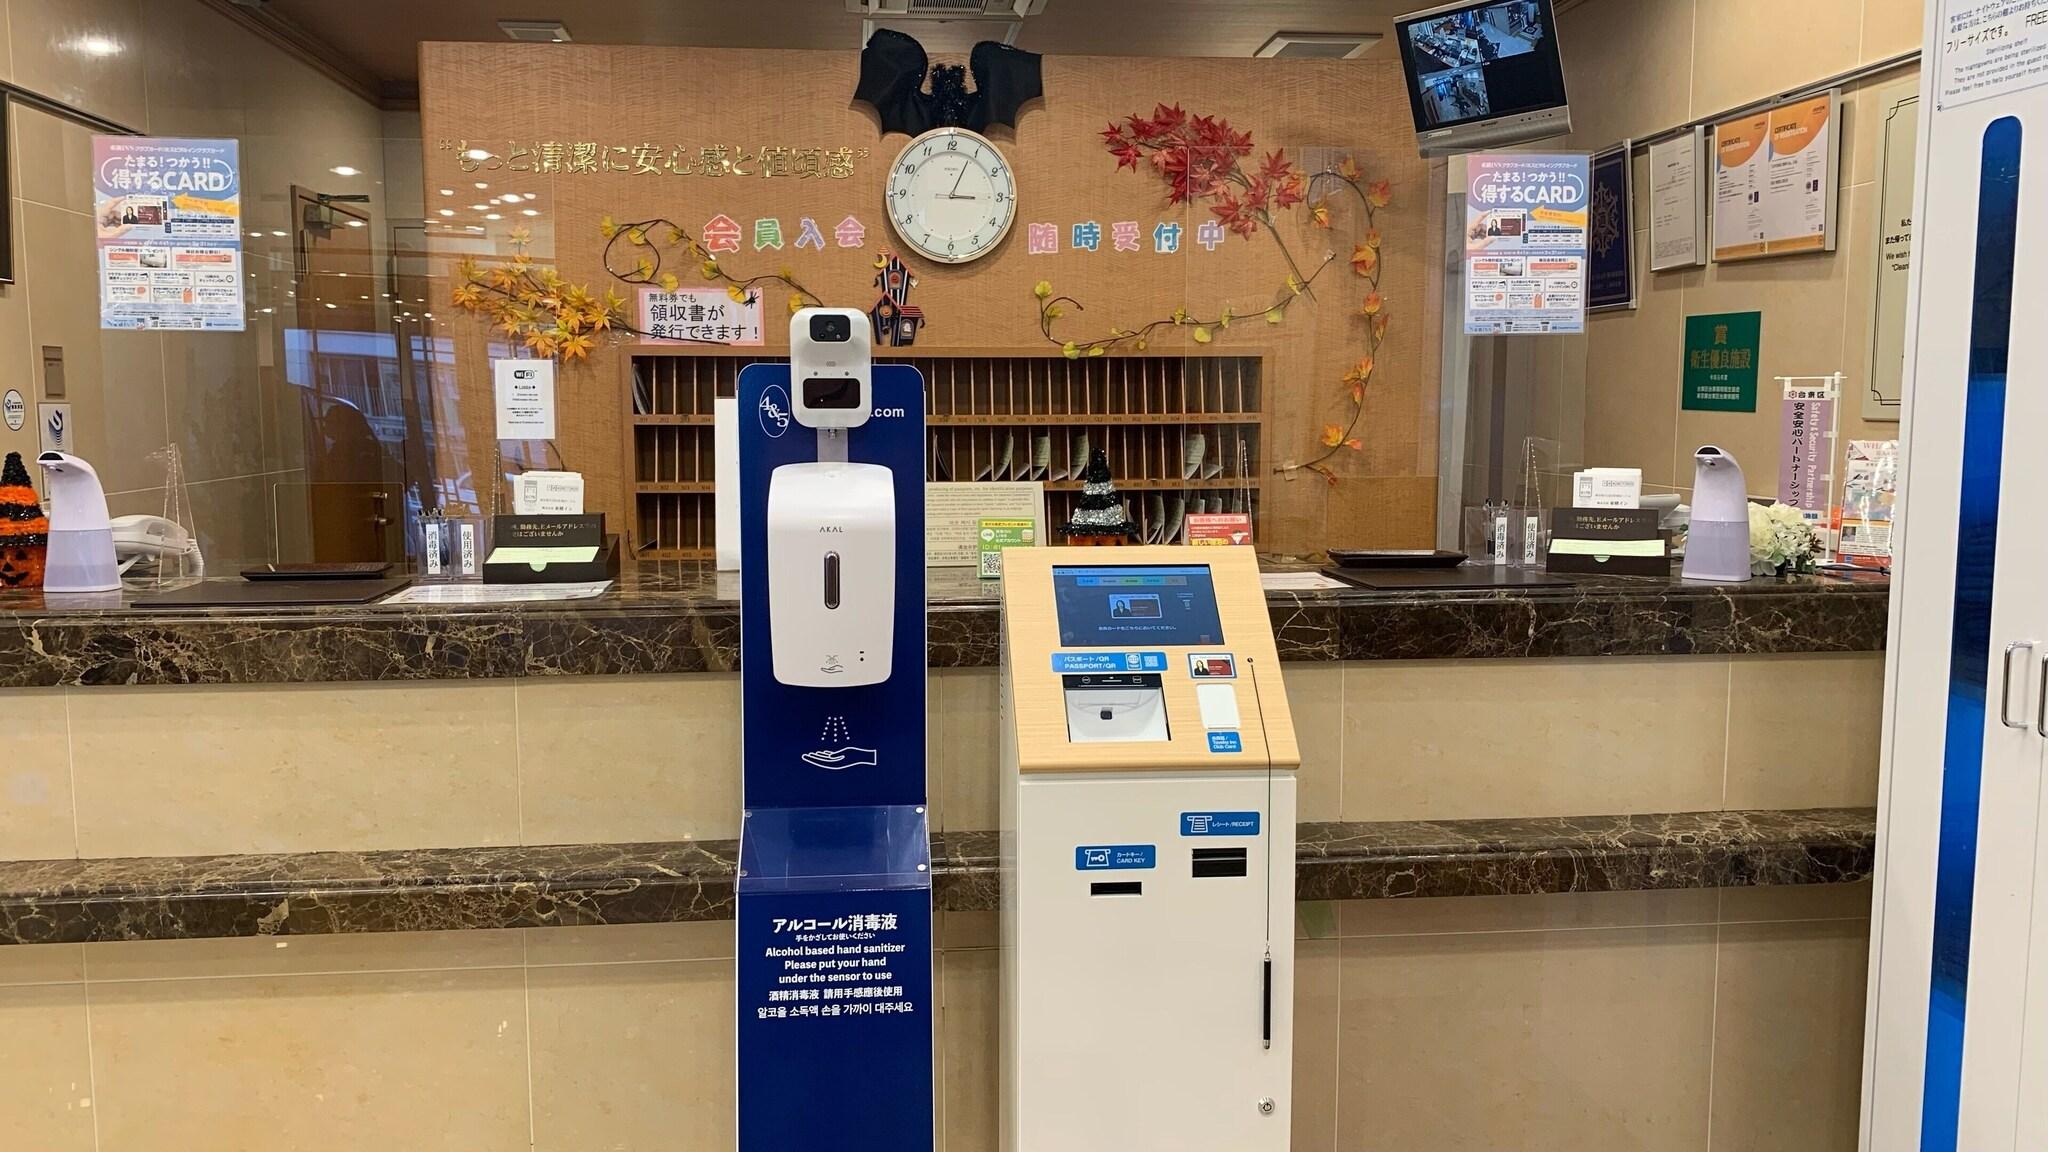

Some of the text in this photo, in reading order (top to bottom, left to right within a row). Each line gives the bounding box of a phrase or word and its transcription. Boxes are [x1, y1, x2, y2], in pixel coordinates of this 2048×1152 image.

[2025, 10, 2048, 28] FREE
[1947, 25, 2008, 53] フリーサイズです。
[923, 147, 931, 156] 11
[947, 141, 958, 150] 12
[974, 149, 979, 158] 1
[904, 164, 915, 174] 10
[991, 167, 998, 177] 2
[112, 168, 225, 191] 得するCARD
[899, 189, 906, 199] 9
[996, 193, 1003, 202] 3
[1481, 184, 1577, 204] 得するCARD
[905, 215, 913, 224] 8
[989, 217, 997, 227] 4
[703, 213, 866, 254] 会員入会
[924, 233, 931, 243] 7
[971, 235, 979, 245] 5
[1028, 220, 1225, 255] 随時受付中
[947, 241, 954, 250] 6
[648, 292, 697, 303] 無料券でも
[650, 303, 725, 322] 領収書が
[650, 322, 759, 341] 発行できます！
[1714, 324, 1728, 345] 賞
[1788, 402, 1805, 507] 安全安心パートナーシップ
[1805, 465, 1817, 508] Partnership
[1526, 522, 1537, 558] 使用済み
[428, 531, 439, 569] 消毒済み
[462, 531, 474, 569] 使用済み
[772, 913, 898, 933] アルコール消毒液
[795, 932, 876, 943] 手をかざしてお使いください
[765, 943, 905, 957] Alcohol based hand sanitizer
[784, 957, 887, 971] Please put your hand
[778, 971, 892, 984] under the sensor to use
[769, 986, 903, 1002] 酒精消毒液 請用手感應後使用
[757, 1001, 913, 1019] 알코올 소독액 손을 가까이 대주세요
